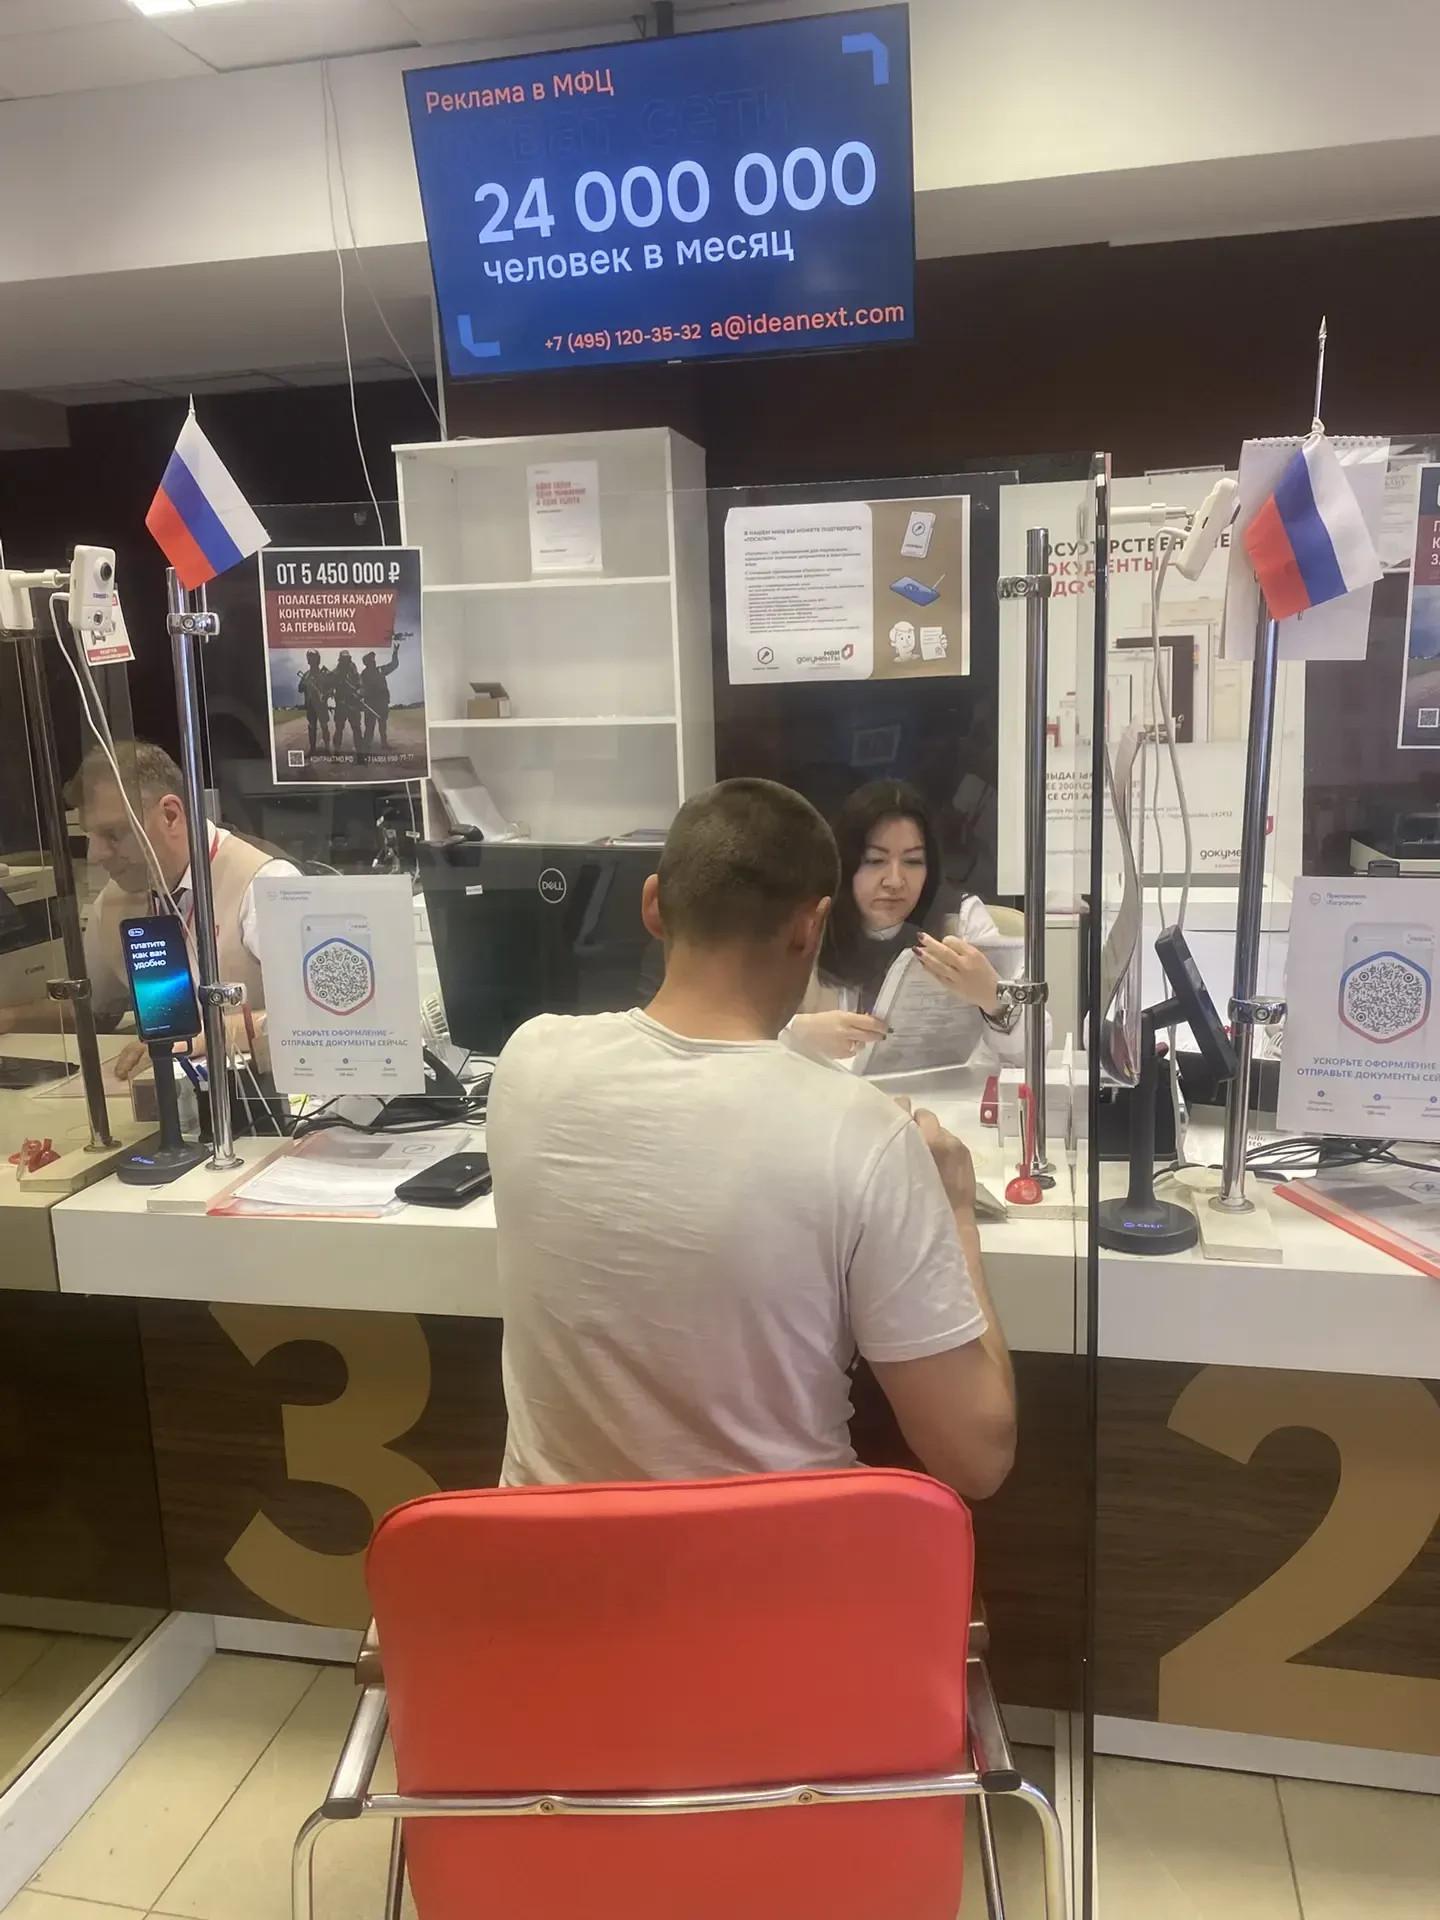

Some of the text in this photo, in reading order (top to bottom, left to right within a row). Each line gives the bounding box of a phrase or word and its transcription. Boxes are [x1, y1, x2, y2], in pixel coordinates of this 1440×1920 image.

[425, 68, 614, 114] Реклама в МФЦ
[473, 140, 877, 244] 24 000 000
[482, 229, 795, 285] человек в месяц
[544, 304, 905, 354] +7 (495) 120-35-32 a@ideanext.com
[276, 562, 297, 585] ОТ
[301, 562, 313, 585] 5
[316, 562, 348, 584] 450
[352, 561, 385, 584] 000
[278, 593, 394, 606] ПОЛАГАЕТСЯ КАЖДОМУ
[279, 607, 356, 619] КОНТРАКТНИКУ
[279, 620, 356, 633] ЗА ПЕРВЫЙ ГОД
[541, 881, 563, 891] DELL
[130, 940, 166, 950] платите
[132, 951, 149, 959] как
[133, 959, 166, 970] удобно
[291, 1029, 330, 1037] УСКОРЬТЕ
[331, 1029, 387, 1037] ОФОРМЛЕНИЕ
[281, 1038, 408, 1047] ОТПРАВЬТЕ ДОКУМЕНТЫ СЕЙЧАС
[1313, 1057, 1437, 1070] УСКОРЬТЕ ОФОРМЛЕНИЕ
[1297, 1067, 1353, 1078] ОТПРАВЬТЕ
[1354, 1070, 1420, 1082] ДОКУМЕНТЫ
[208, 1301, 443, 1631] 3
[1158, 1364, 1440, 1757] 2
